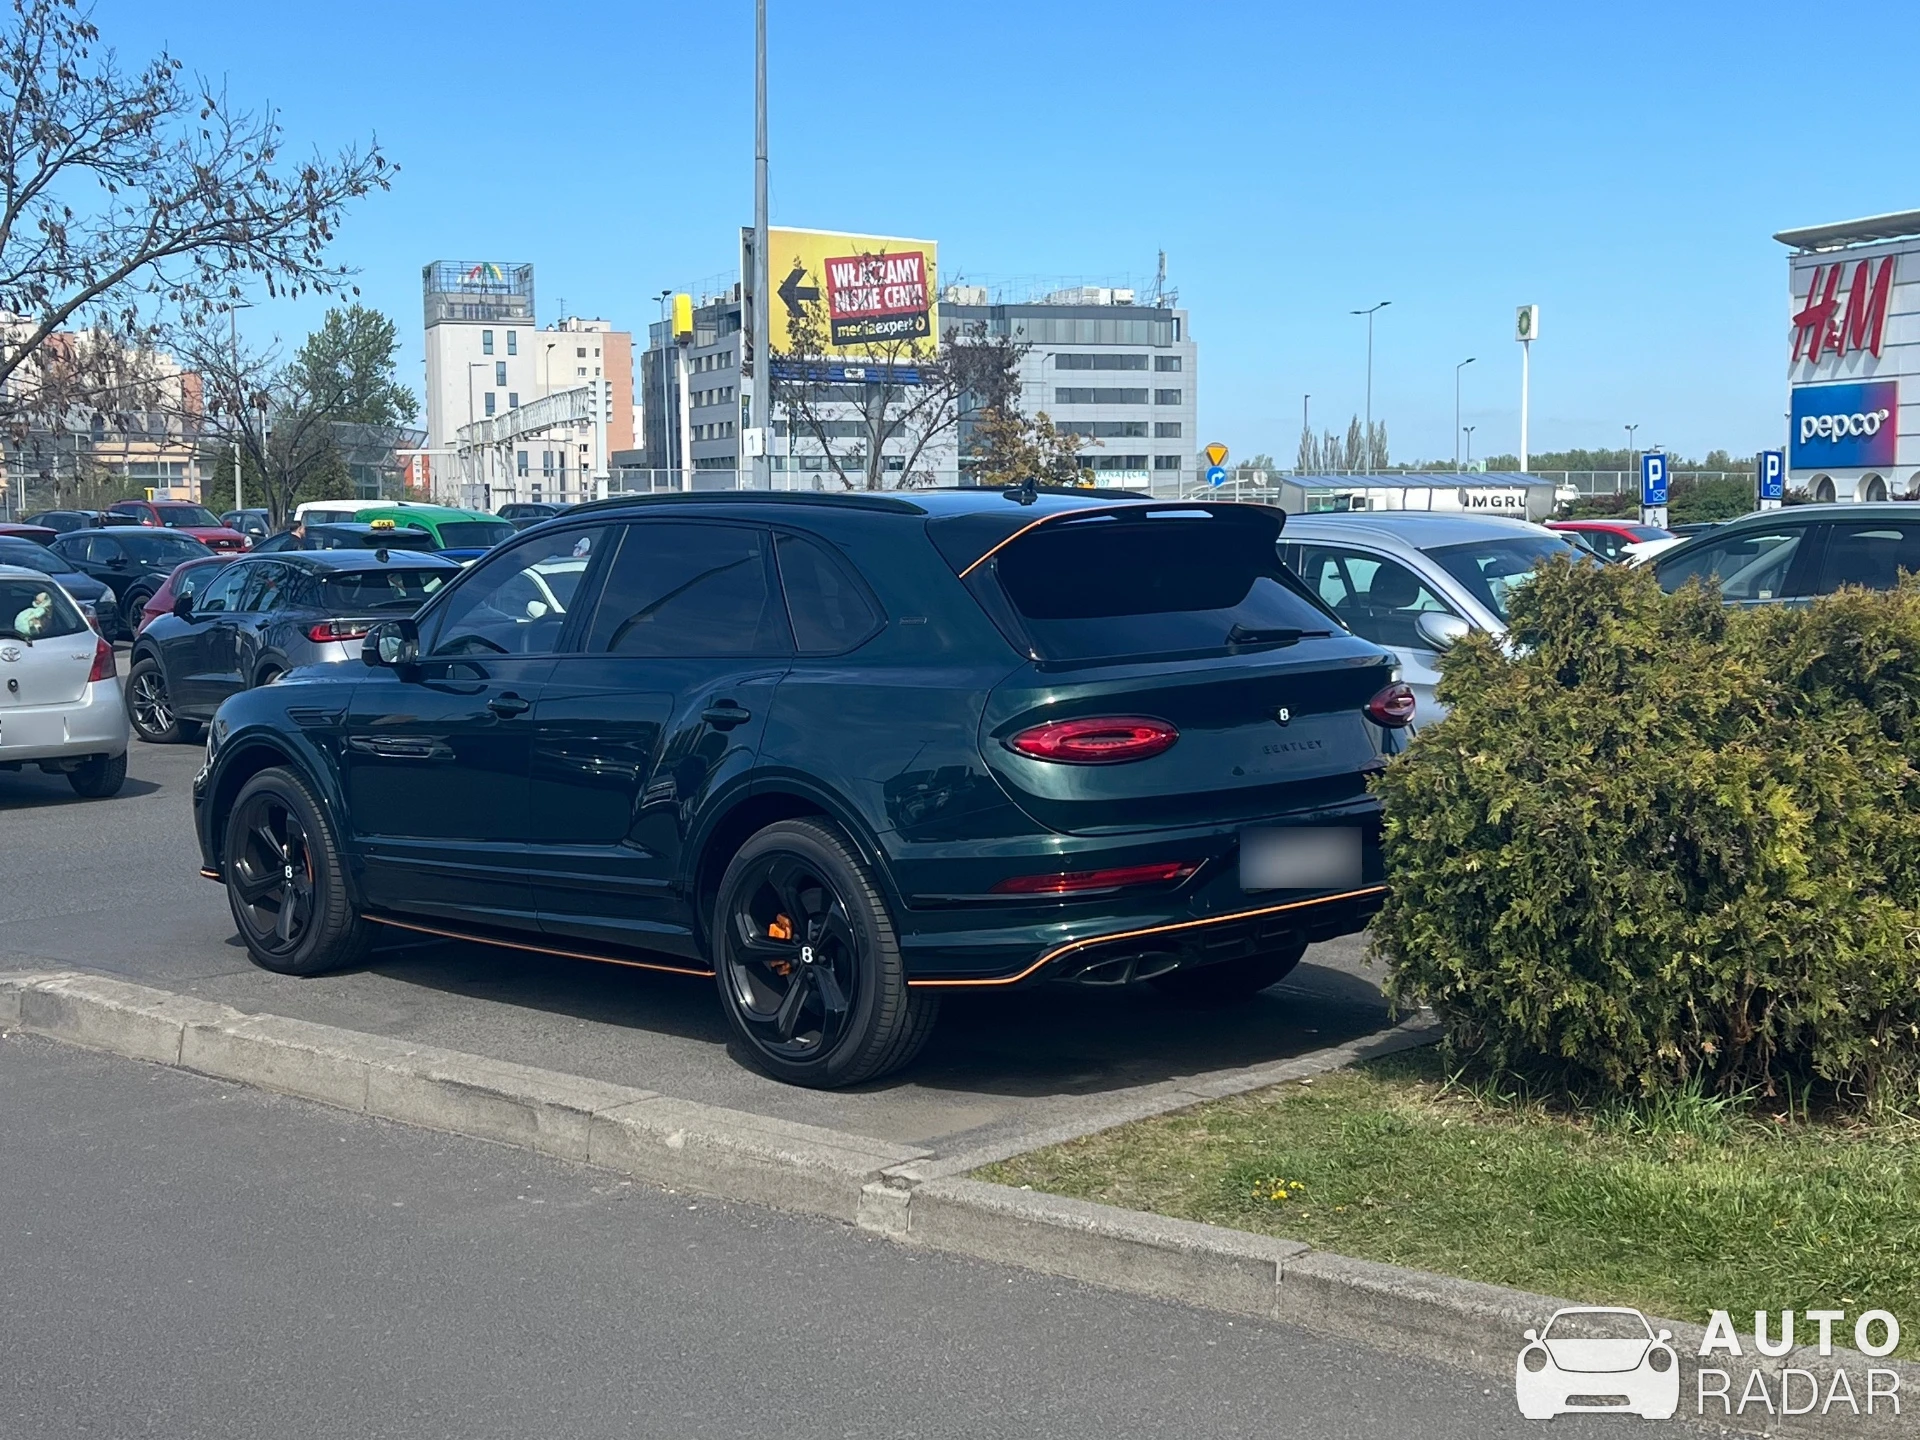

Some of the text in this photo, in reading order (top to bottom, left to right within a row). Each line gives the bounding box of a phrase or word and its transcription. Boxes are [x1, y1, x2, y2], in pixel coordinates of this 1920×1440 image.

[834, 287, 881, 312] NISKIE
[1792, 255, 1895, 363] H&M
[1801, 412, 1880, 444] pepco
[748, 435, 754, 451] 1
[1648, 459, 1662, 489] P
[1767, 455, 1779, 484] P
[1262, 740, 1322, 754] BENTLEY
[802, 946, 813, 963] B
